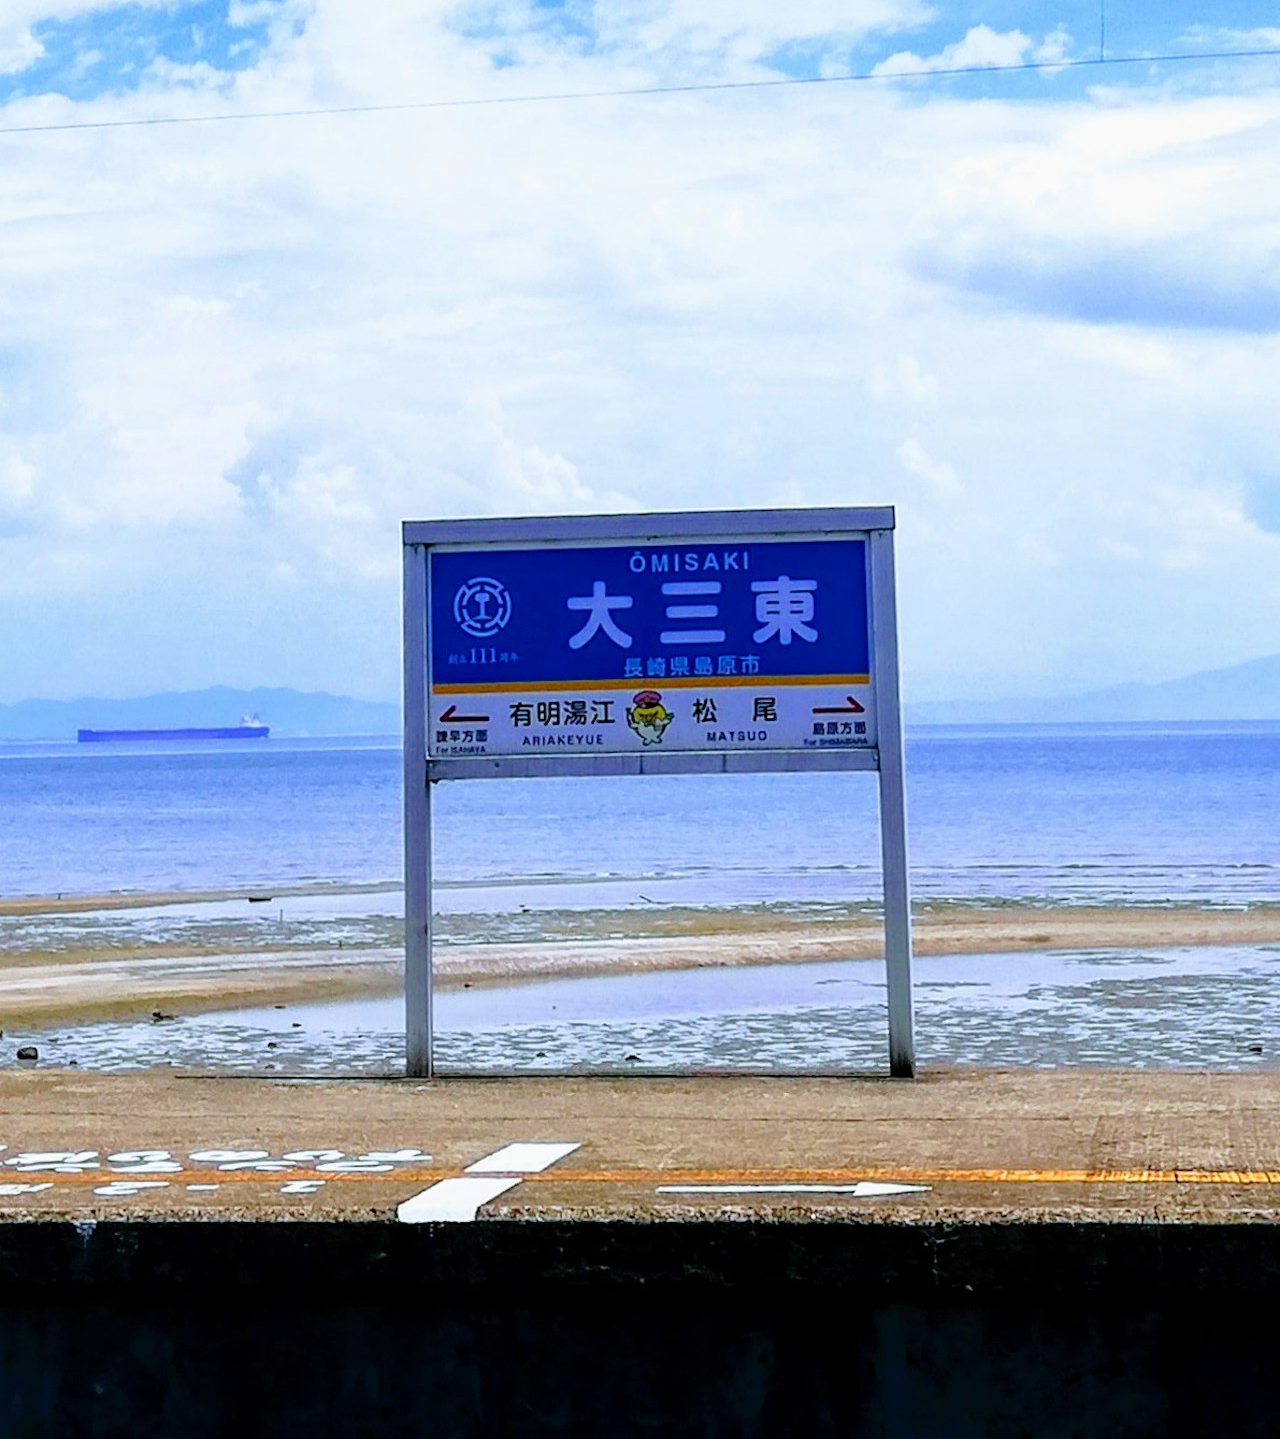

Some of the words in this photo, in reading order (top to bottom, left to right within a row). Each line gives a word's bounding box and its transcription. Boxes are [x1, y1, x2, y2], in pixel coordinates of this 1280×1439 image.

[566, 575, 819, 650] 大三東
[623, 654, 761, 678] 長崎県島原市
[509, 699, 616, 728] 有明湯江
[522, 733, 604, 747] ARIAKEYUE
[706, 730, 768, 743] MATSUO
